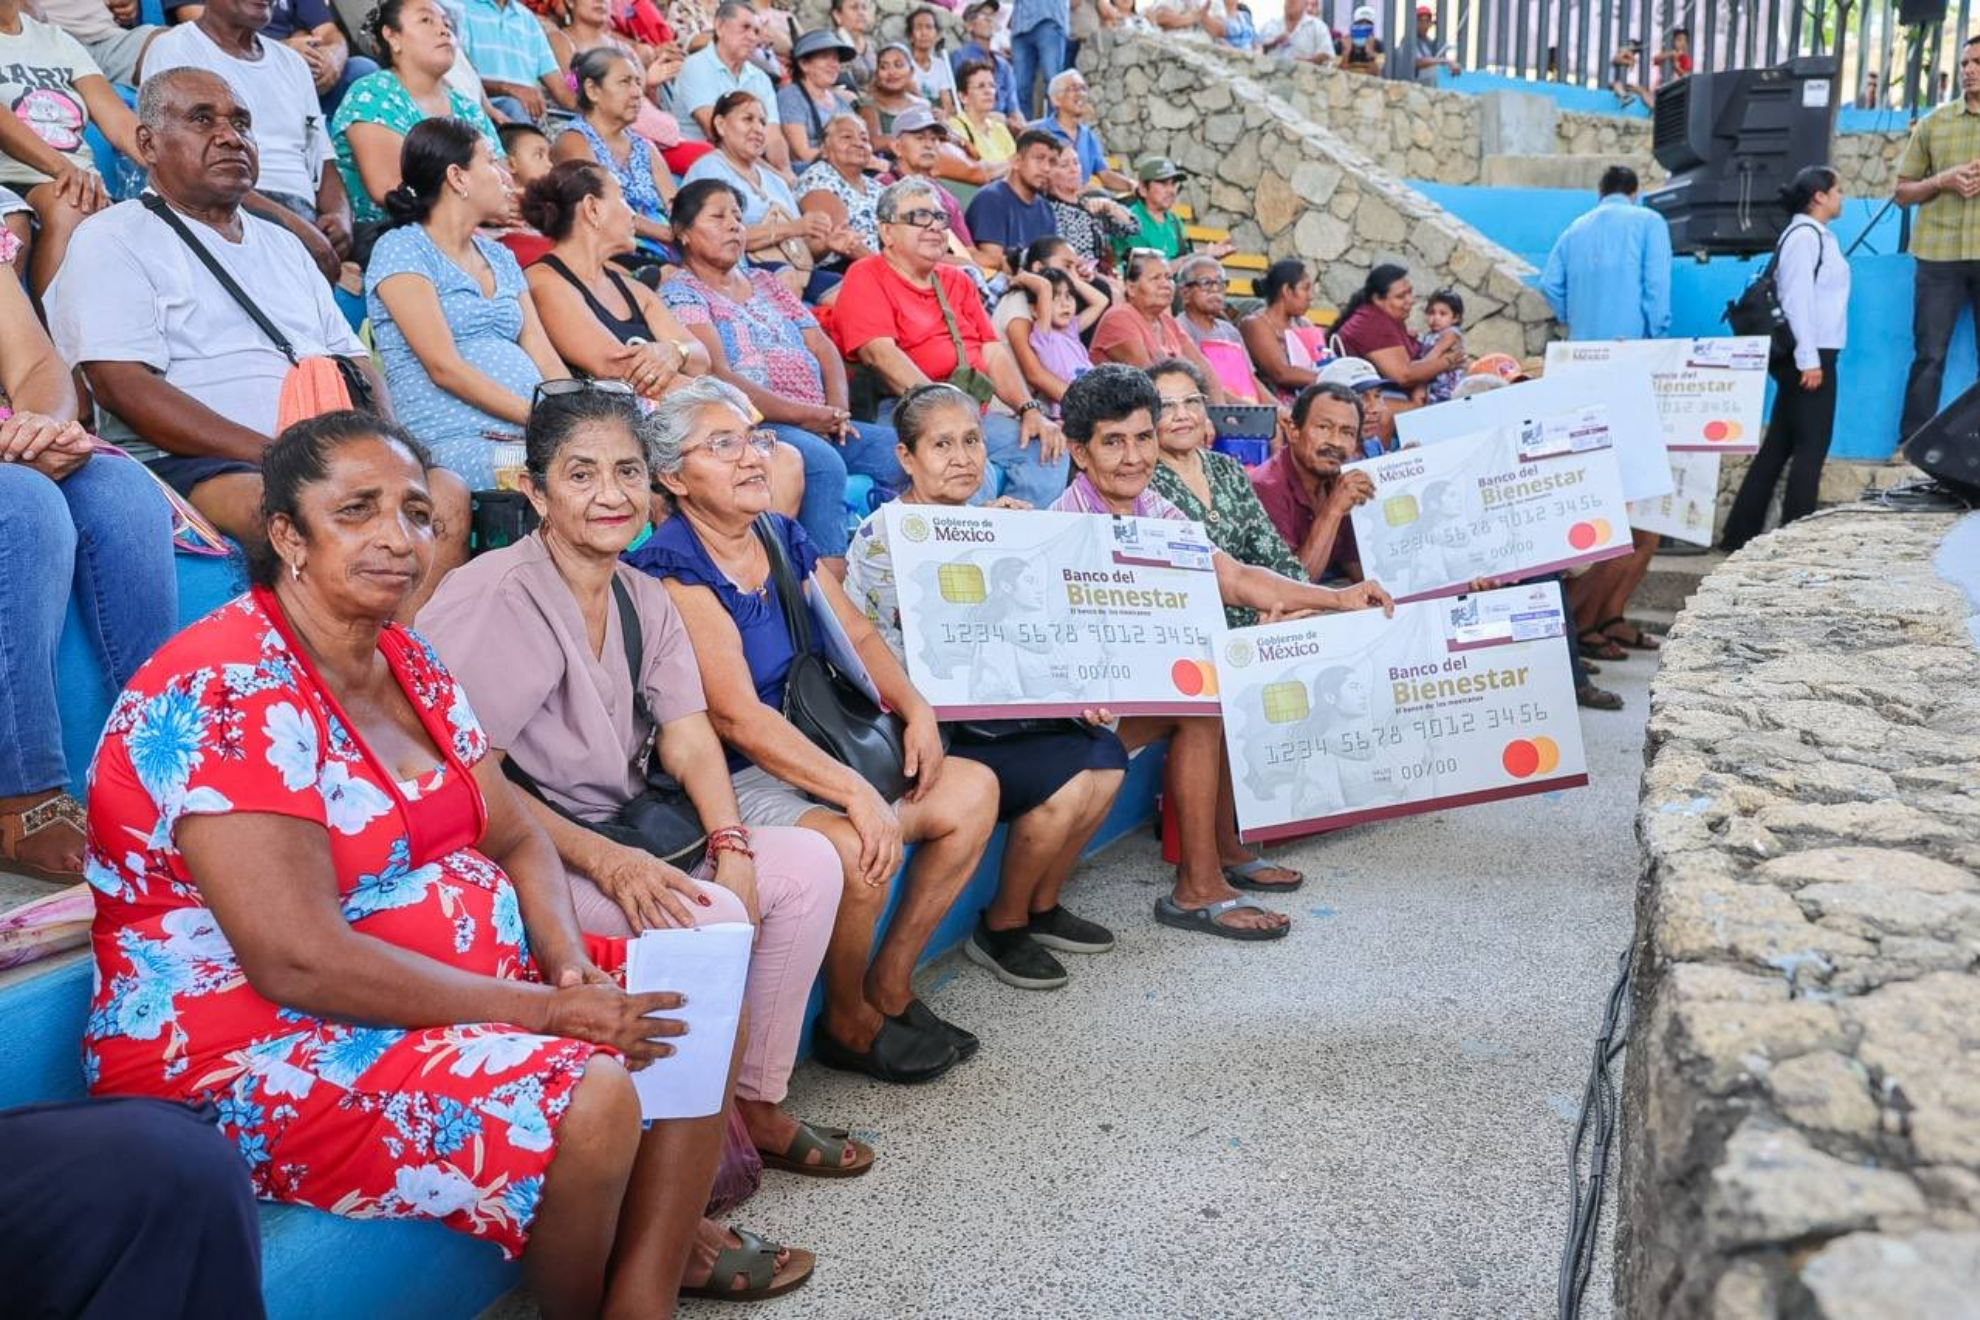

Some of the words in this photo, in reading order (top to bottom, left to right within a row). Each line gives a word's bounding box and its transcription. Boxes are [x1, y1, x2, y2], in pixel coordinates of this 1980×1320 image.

[1379, 465, 1425, 484] México
[1477, 471, 1516, 488] Banco
[1519, 463, 1538, 478] del
[1480, 467, 1586, 505] Bienestar
[1553, 494, 1604, 517] 3456
[932, 516, 980, 527] Gobierno
[981, 518, 993, 528] de
[934, 526, 995, 543] México
[1489, 539, 1534, 560] 00/00
[1062, 568, 1109, 582] Banco
[1112, 569, 1135, 584] del
[1065, 582, 1188, 609] Bienestar
[940, 622, 1005, 643] 1234
[1018, 622, 1078, 643] 5678
[1087, 623, 1147, 644] 9012
[1153, 625, 1208, 646] 3456
[1256, 634, 1304, 646] Gobierno
[1305, 630, 1318, 640] de
[1259, 641, 1320, 662] México
[1078, 664, 1131, 680] 00/00
[1388, 662, 1439, 681] Banco
[1442, 655, 1468, 672] del
[1391, 666, 1529, 706] Bienestar
[1402, 703, 1424, 713] banco
[1425, 701, 1435, 710] de
[1436, 700, 1447, 708] los
[1447, 695, 1485, 706] mexicanos
[1264, 736, 1328, 766] 1234
[1341, 724, 1403, 753] 5678
[1412, 712, 1476, 740] 9012
[1485, 702, 1549, 730] 3456
[1401, 757, 1458, 781] 00/00
